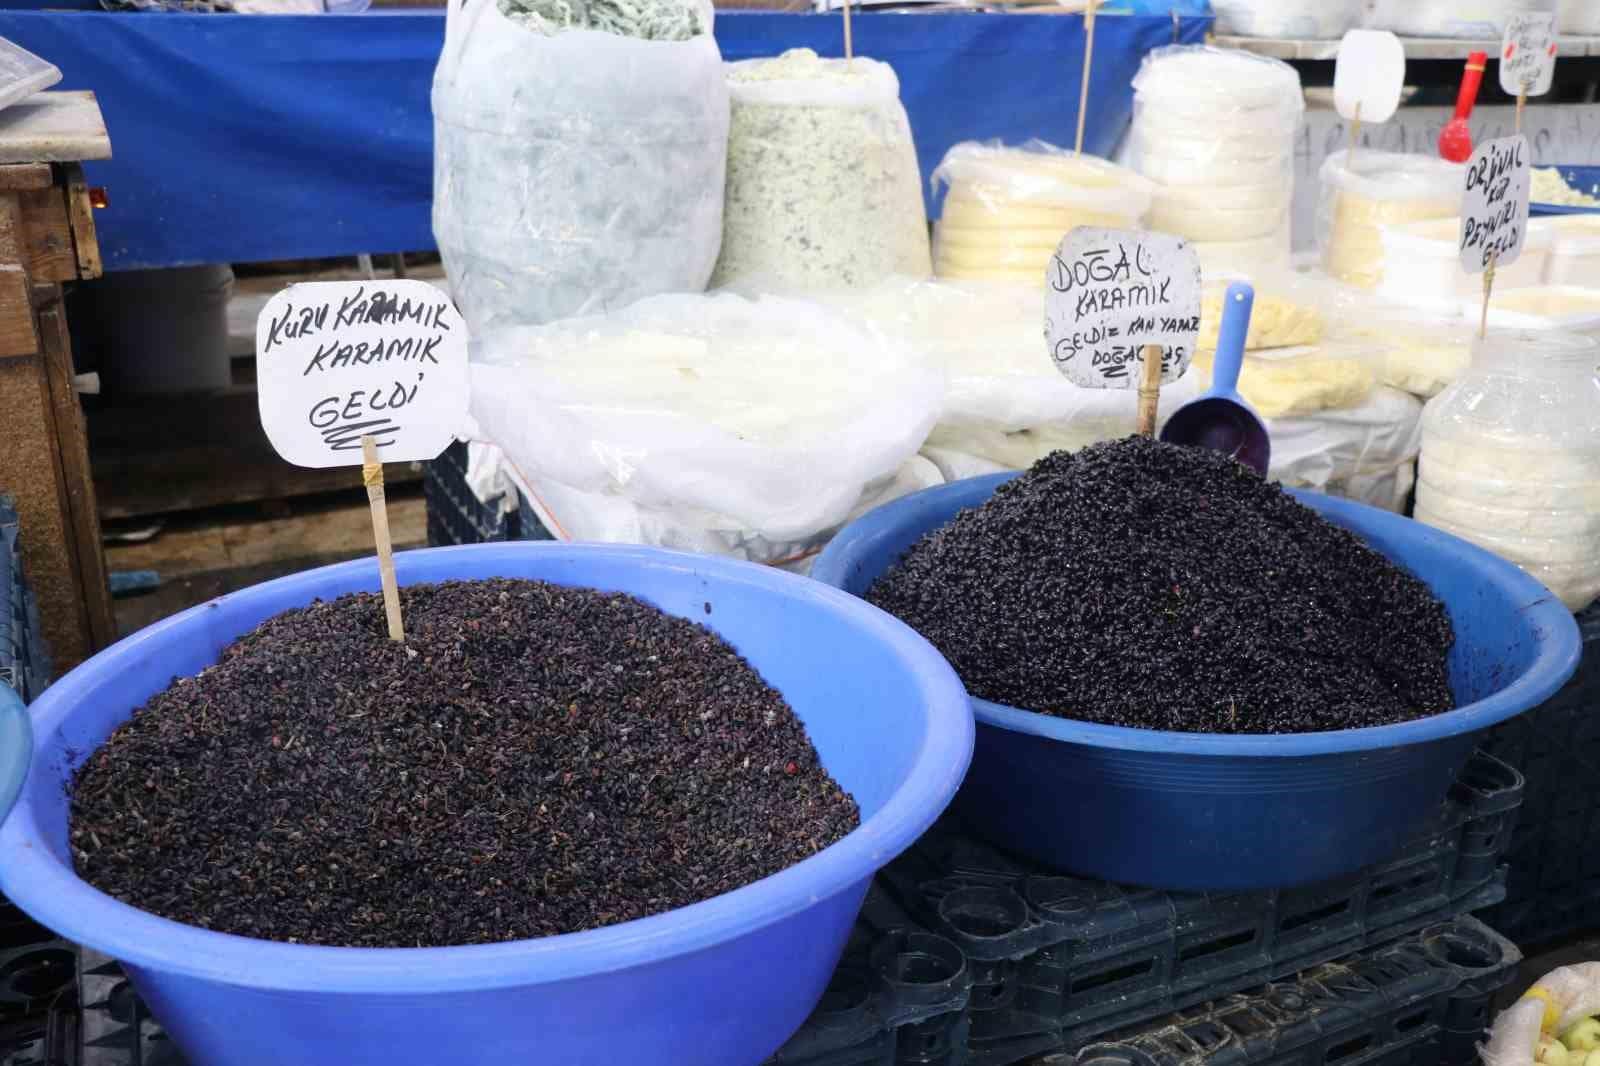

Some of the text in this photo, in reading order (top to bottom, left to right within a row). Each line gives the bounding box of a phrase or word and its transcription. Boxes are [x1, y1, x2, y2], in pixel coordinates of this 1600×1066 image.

[1075, 277, 1171, 322] KARAMIK
[264, 303, 330, 352] KURU
[1127, 311, 1155, 336] KAN
[303, 335, 442, 376] KARAMIK
[309, 372, 424, 428] GELDİ
